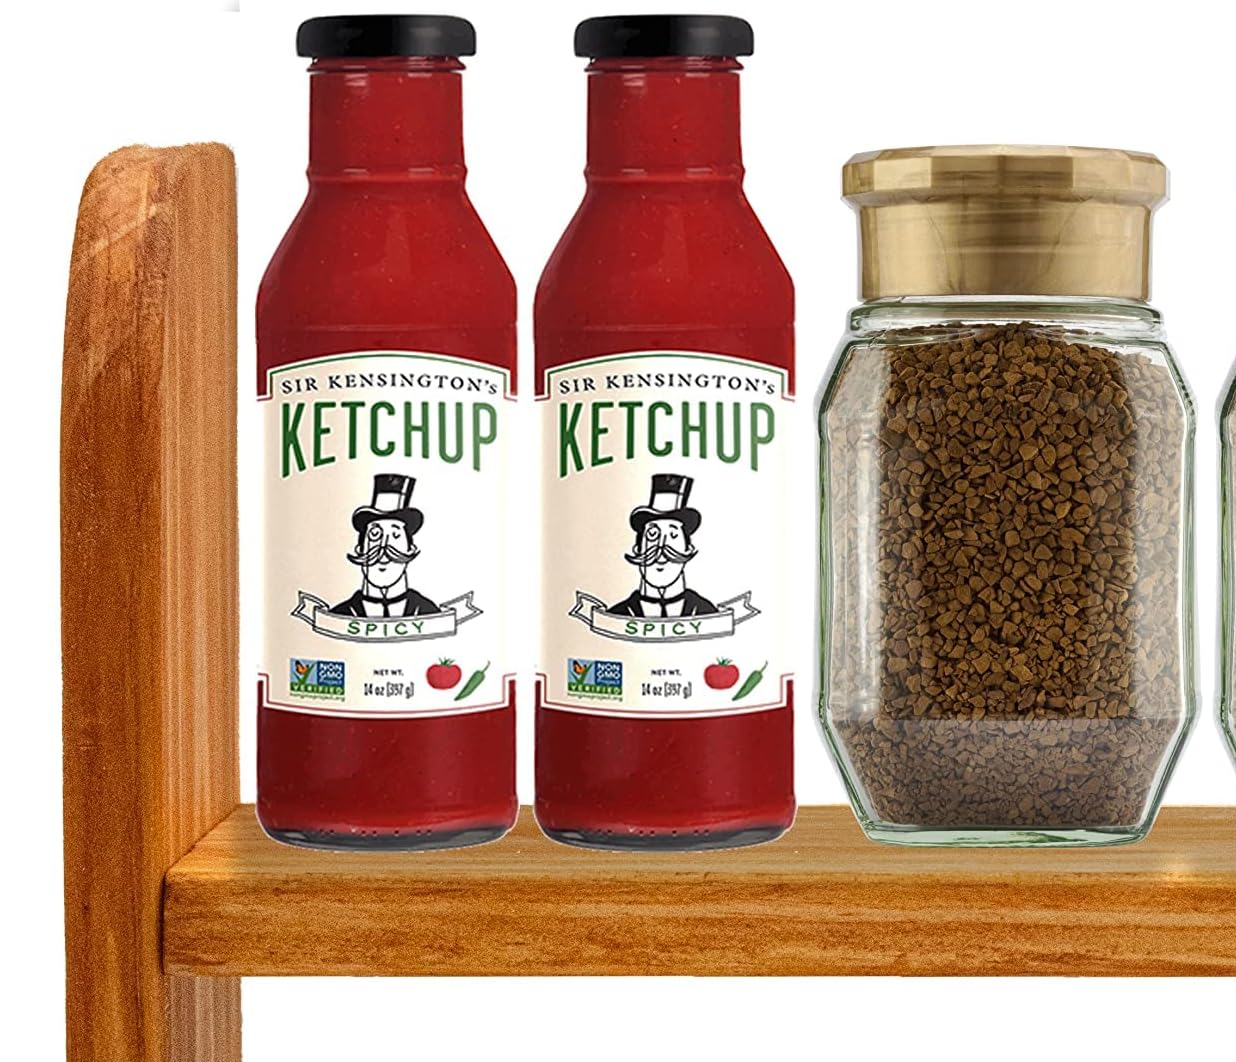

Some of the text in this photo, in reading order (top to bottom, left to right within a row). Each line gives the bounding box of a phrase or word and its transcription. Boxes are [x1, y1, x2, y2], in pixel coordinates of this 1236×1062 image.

[281, 378, 318, 394] SIR
[559, 378, 596, 394] SIR
[282, 401, 498, 478] KETCHUP
[560, 401, 776, 478] KETCHUP
[347, 620, 424, 637] SPICY
[625, 620, 702, 637] SPICY
[319, 663, 343, 671] NON
[597, 663, 621, 671] NON
[319, 671, 343, 679] GMO
[597, 671, 621, 679] GMO
[364, 682, 373, 696] 14
[374, 686, 385, 696] oz
[642, 682, 651, 696] 14
[652, 686, 663, 696] oz
